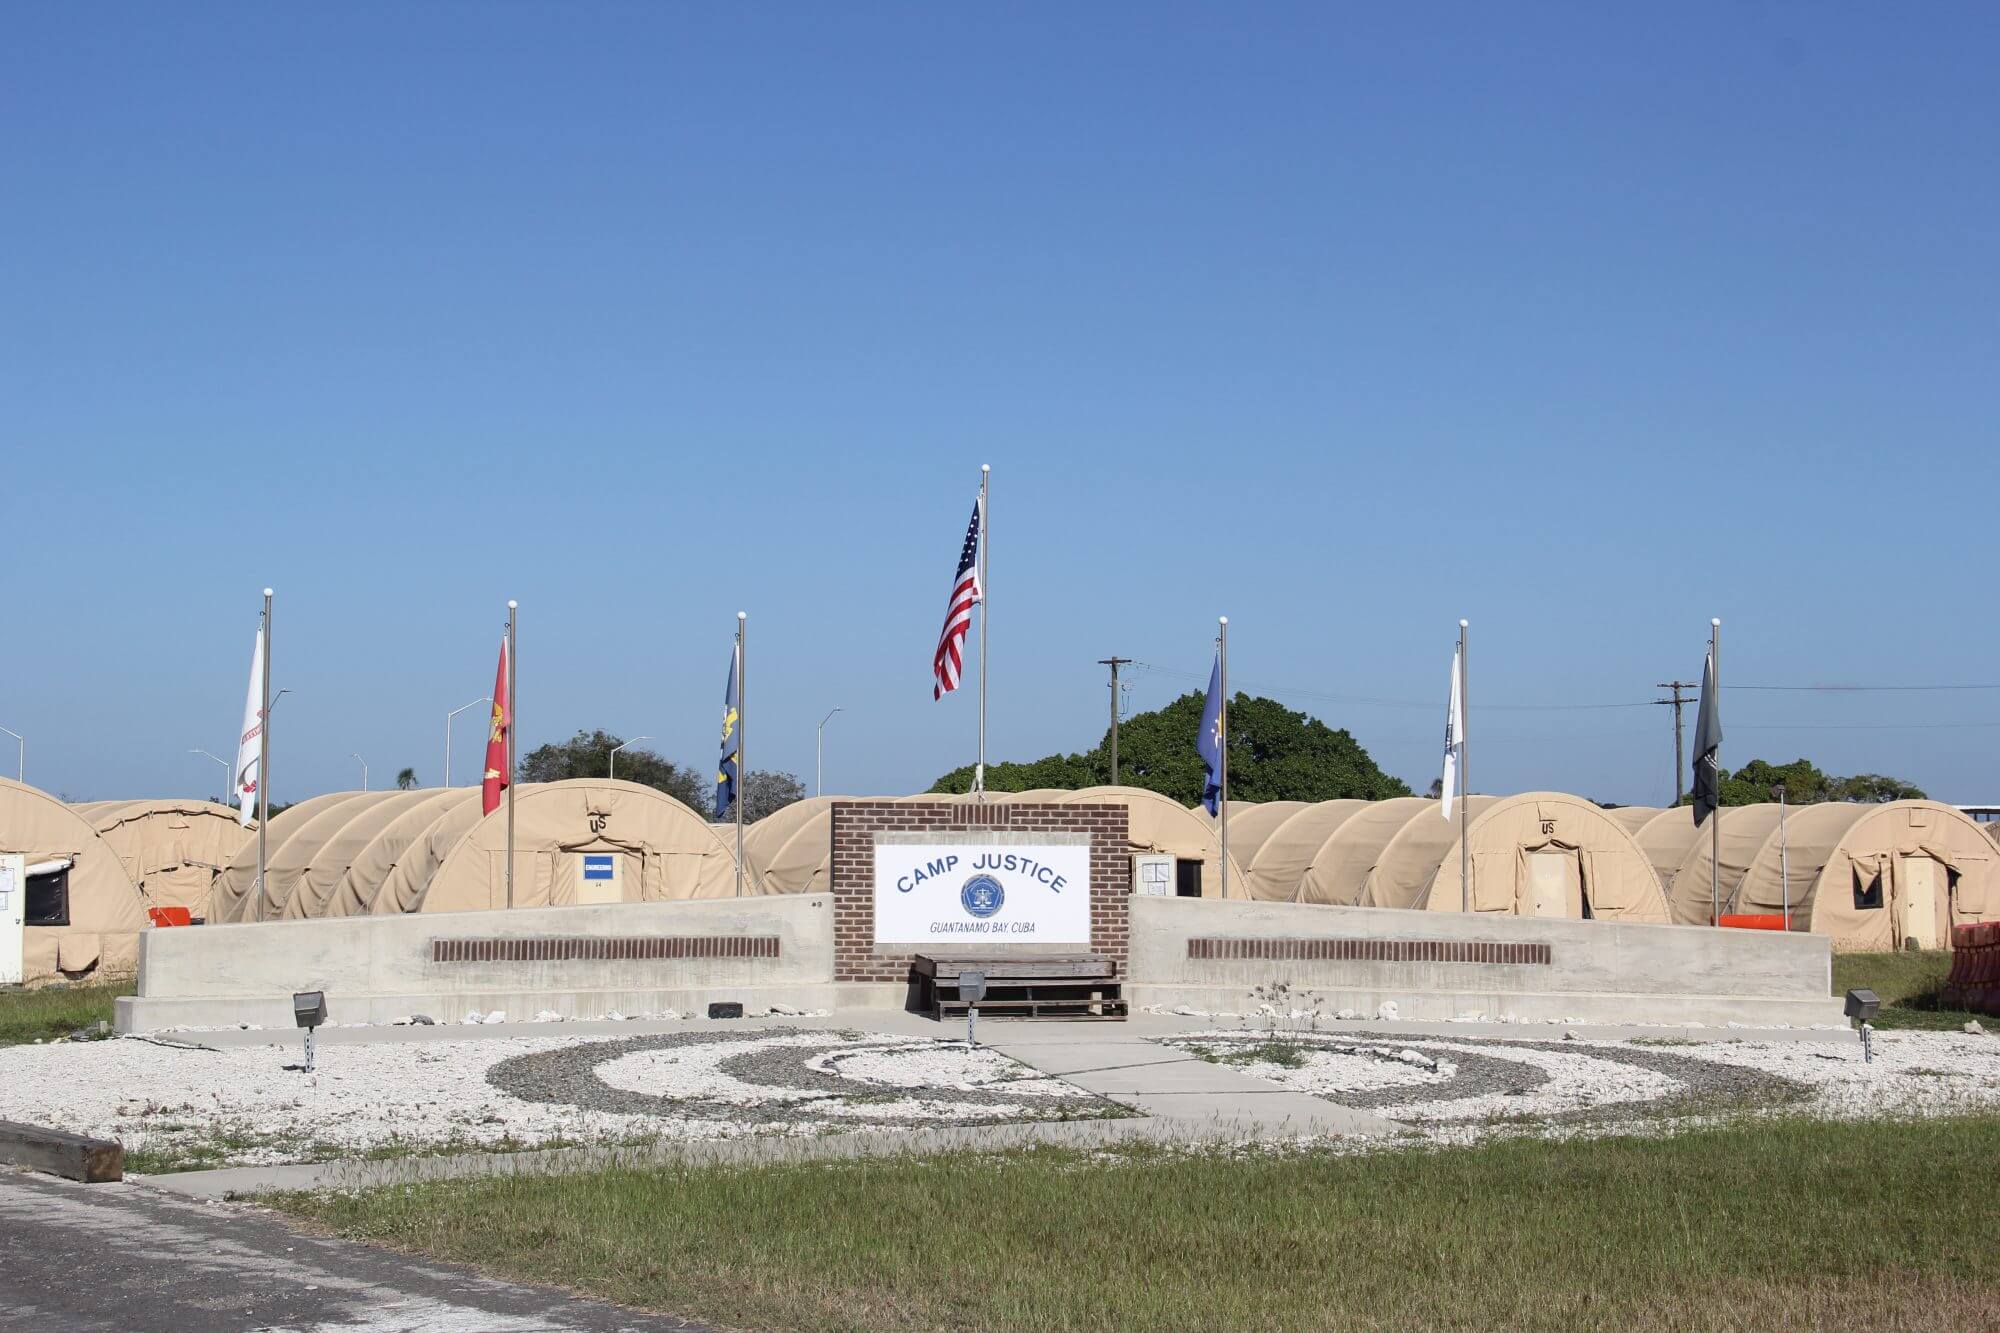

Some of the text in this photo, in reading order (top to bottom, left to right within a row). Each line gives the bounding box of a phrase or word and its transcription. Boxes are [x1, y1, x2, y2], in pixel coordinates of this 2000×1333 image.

[589, 815, 607, 833] US
[1541, 822, 1555, 835] US
[897, 853, 1068, 894] CAMP JUSTICE
[930, 921, 990, 934] GUANTANAMO
[1011, 921, 1036, 934] CUBA
